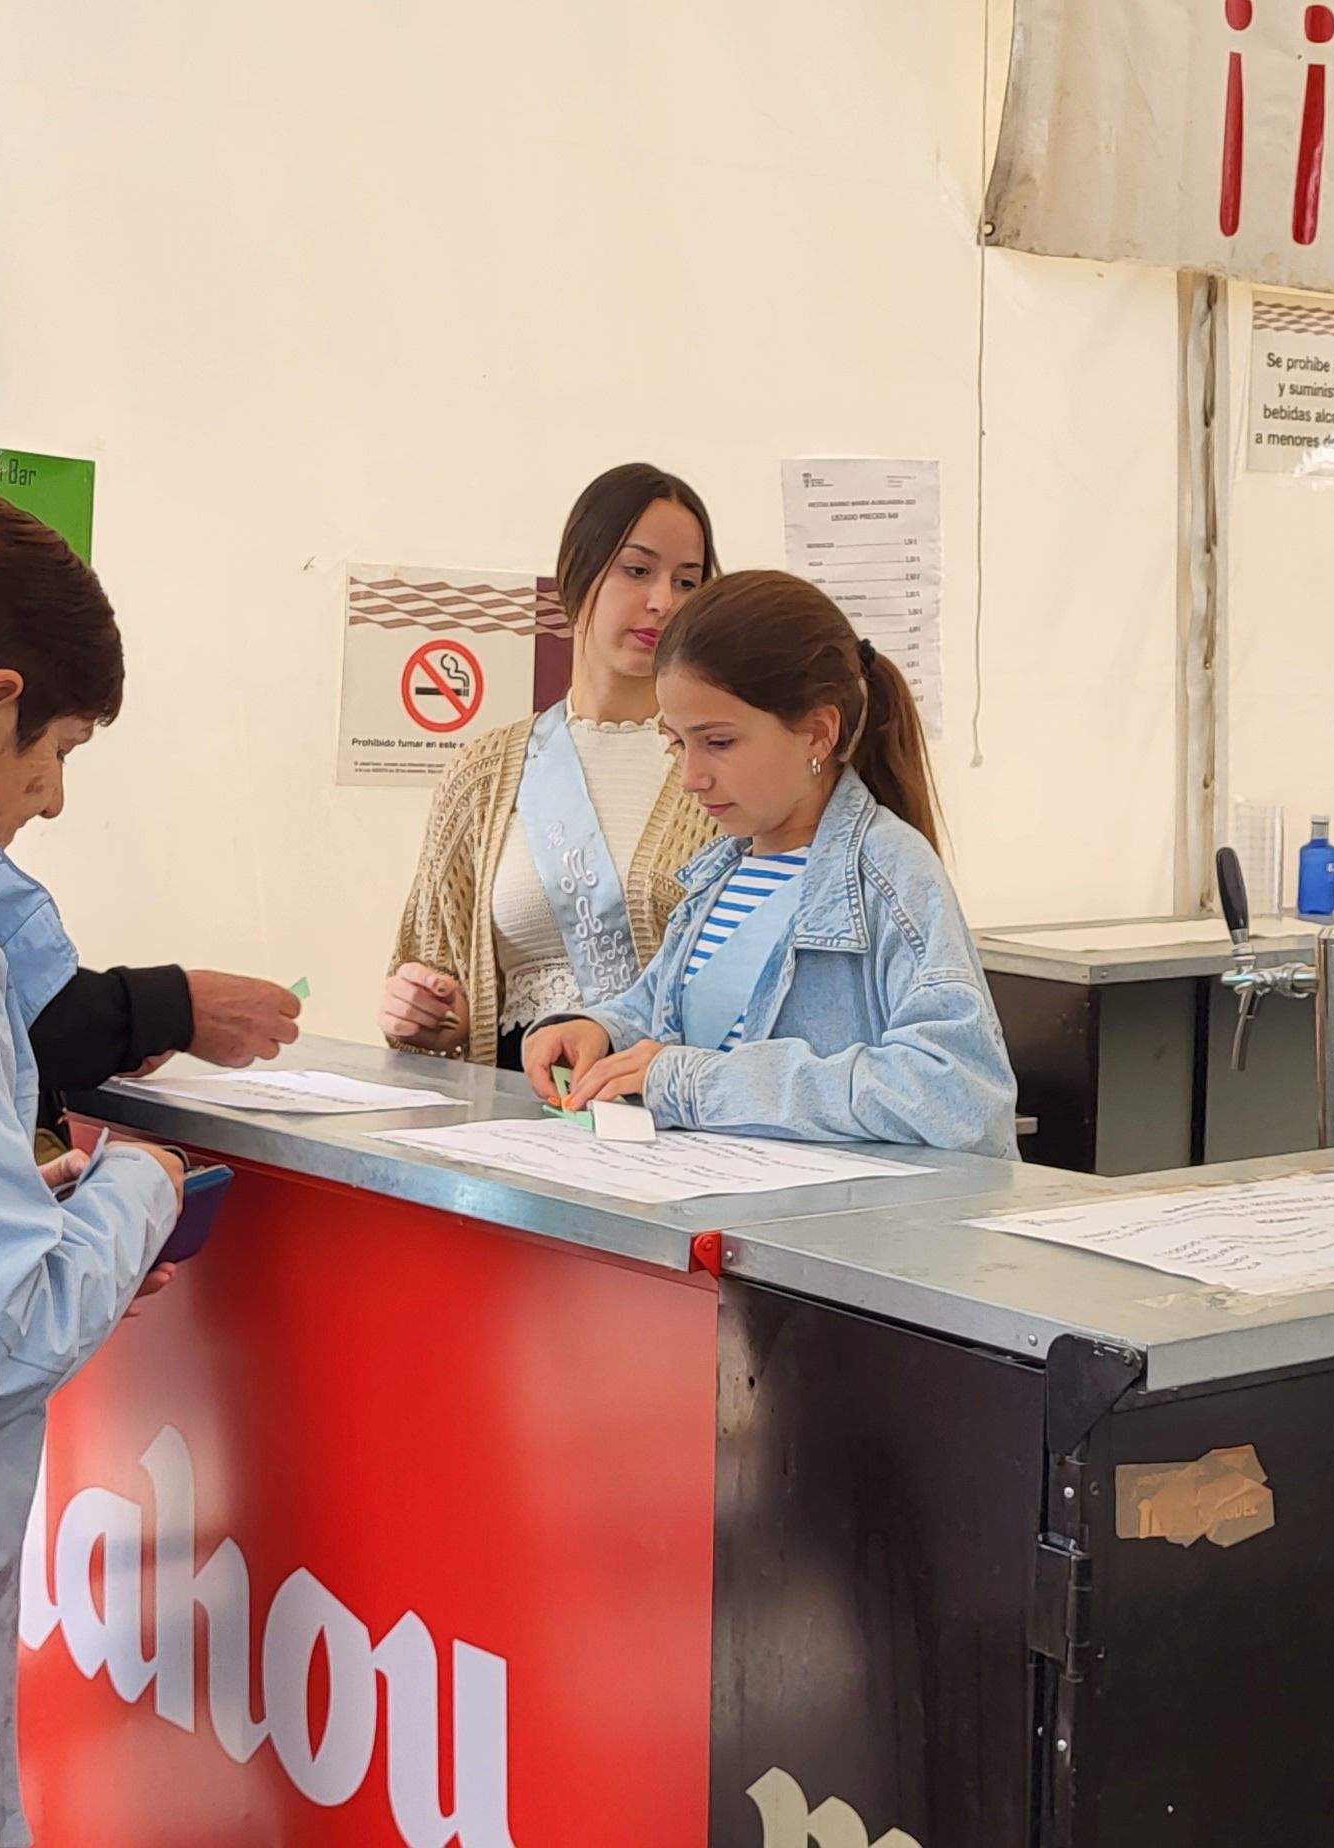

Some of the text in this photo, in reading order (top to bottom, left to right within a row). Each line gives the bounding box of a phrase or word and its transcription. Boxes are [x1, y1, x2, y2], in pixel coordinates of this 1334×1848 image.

[1267, 352, 1282, 368] Se
[1278, 382, 1286, 397] y
[1263, 404, 1312, 422] bebidas
[1255, 432, 1263, 444] a
[1267, 433, 1320, 449] menores
[8, 458, 37, 486] Bar
[351, 737, 396, 748] Prohibido
[398, 738, 424, 748] fumar
[425, 740, 437, 749] en
[19, 1423, 519, 1848] ahou
